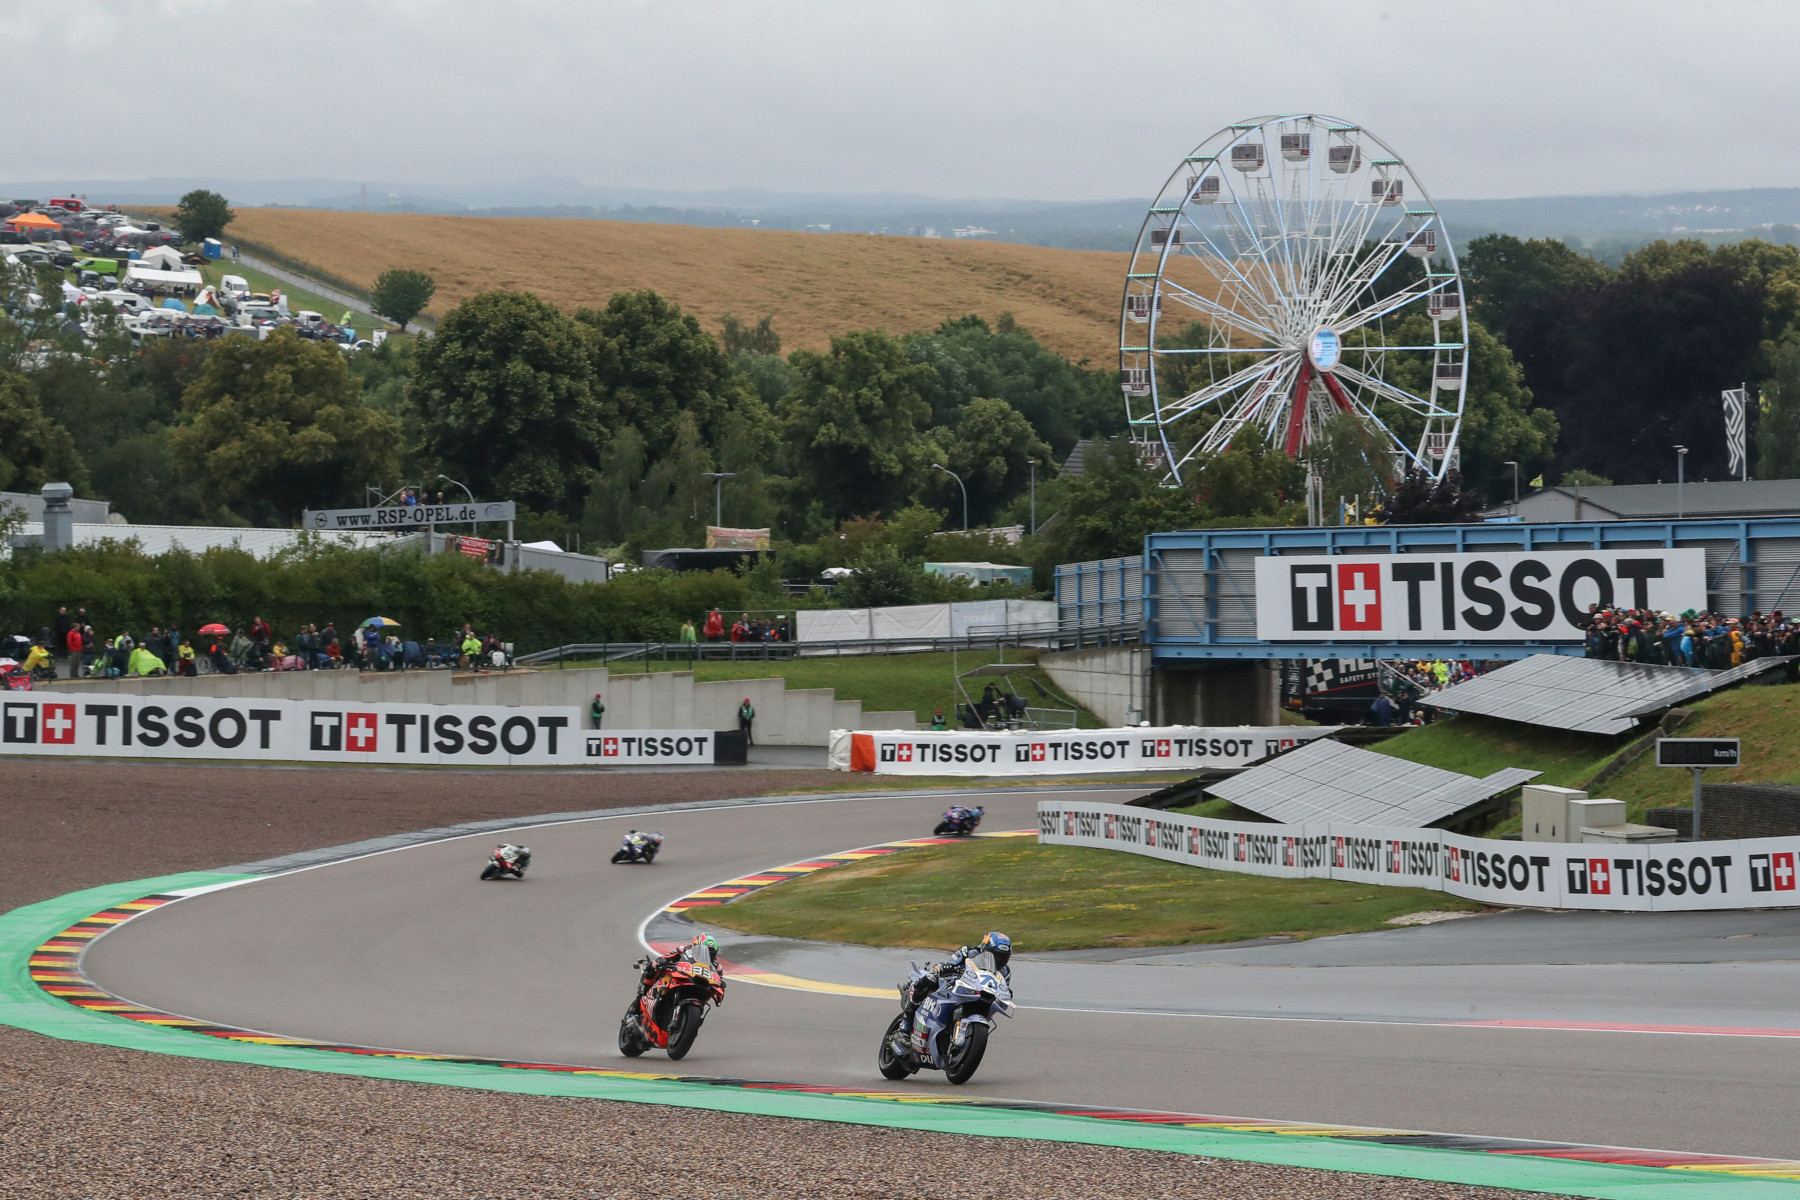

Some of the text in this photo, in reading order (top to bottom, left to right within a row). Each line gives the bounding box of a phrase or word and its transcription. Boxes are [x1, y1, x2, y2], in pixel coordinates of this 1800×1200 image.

[336, 507, 476, 526] www.RSP-OPEL.de
[1392, 559, 1664, 632] TISSOT
[1340, 673, 1364, 684] SAFETY
[85, 704, 281, 749] TISSOT
[383, 714, 568, 755] TISSOT
[622, 737, 707, 756] TISSOT
[916, 744, 1001, 762] TISSOT
[1049, 741, 1129, 760] TISSOT
[1174, 739, 1253, 757] TISSOT
[1074, 812, 1100, 838] TISSOT
[1115, 815, 1142, 843] TISSOT
[1156, 821, 1183, 851] TISSOT
[1199, 829, 1229, 860] TISSOT
[1247, 834, 1278, 865] TISSOT
[1295, 836, 1327, 868] TISSOT
[1345, 837, 1381, 871] TISSOT
[1401, 841, 1439, 876] TISSOT
[1461, 849, 1549, 892] TISSOT
[1614, 856, 1732, 896] TISSOT
[980, 975, 998, 990] 73
